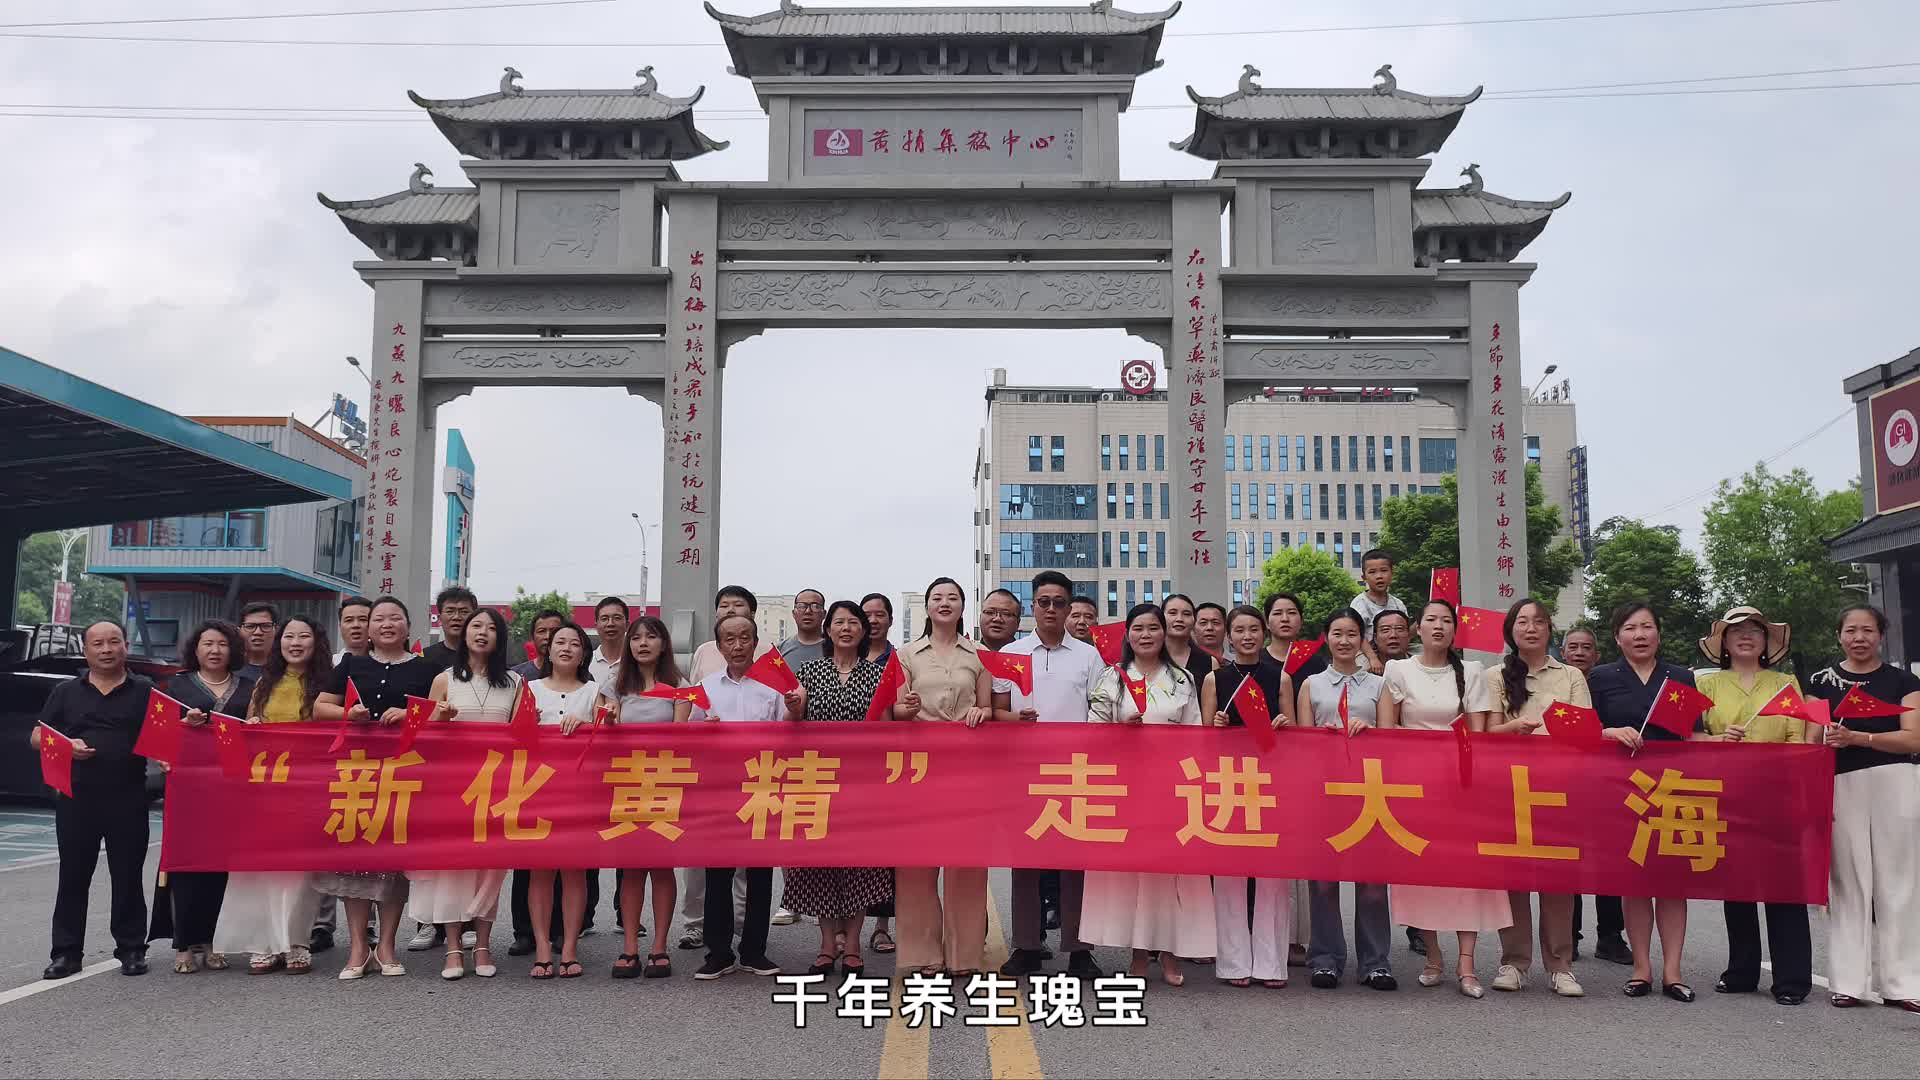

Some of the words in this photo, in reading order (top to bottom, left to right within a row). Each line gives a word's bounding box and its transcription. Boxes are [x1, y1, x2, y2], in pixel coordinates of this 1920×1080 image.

[1025, 753, 1727, 871] 走进大上海
